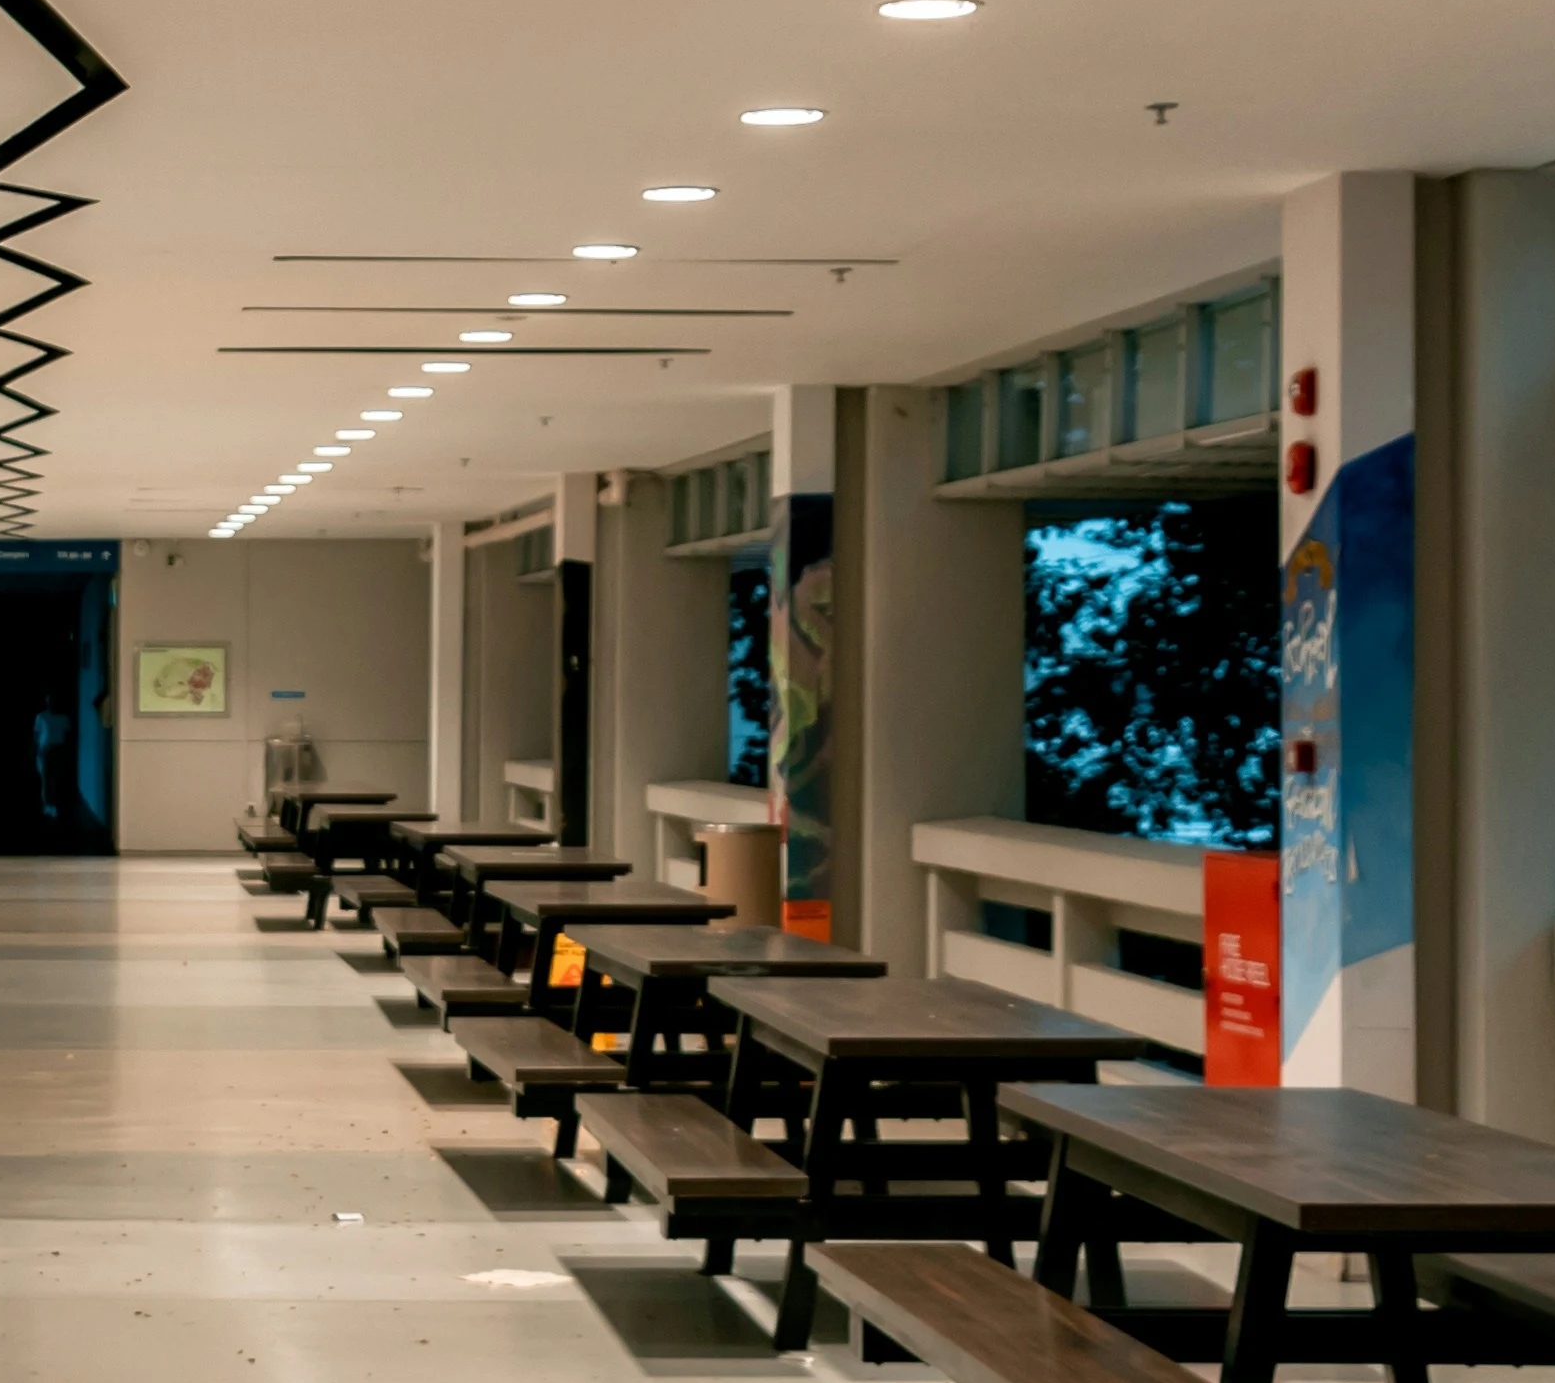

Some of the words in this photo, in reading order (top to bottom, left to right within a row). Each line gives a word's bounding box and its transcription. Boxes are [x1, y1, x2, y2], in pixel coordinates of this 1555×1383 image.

[1218, 932, 1240, 957] FIRE
[1220, 957, 1246, 982] HOSE
[1245, 960, 1270, 988] REEL
